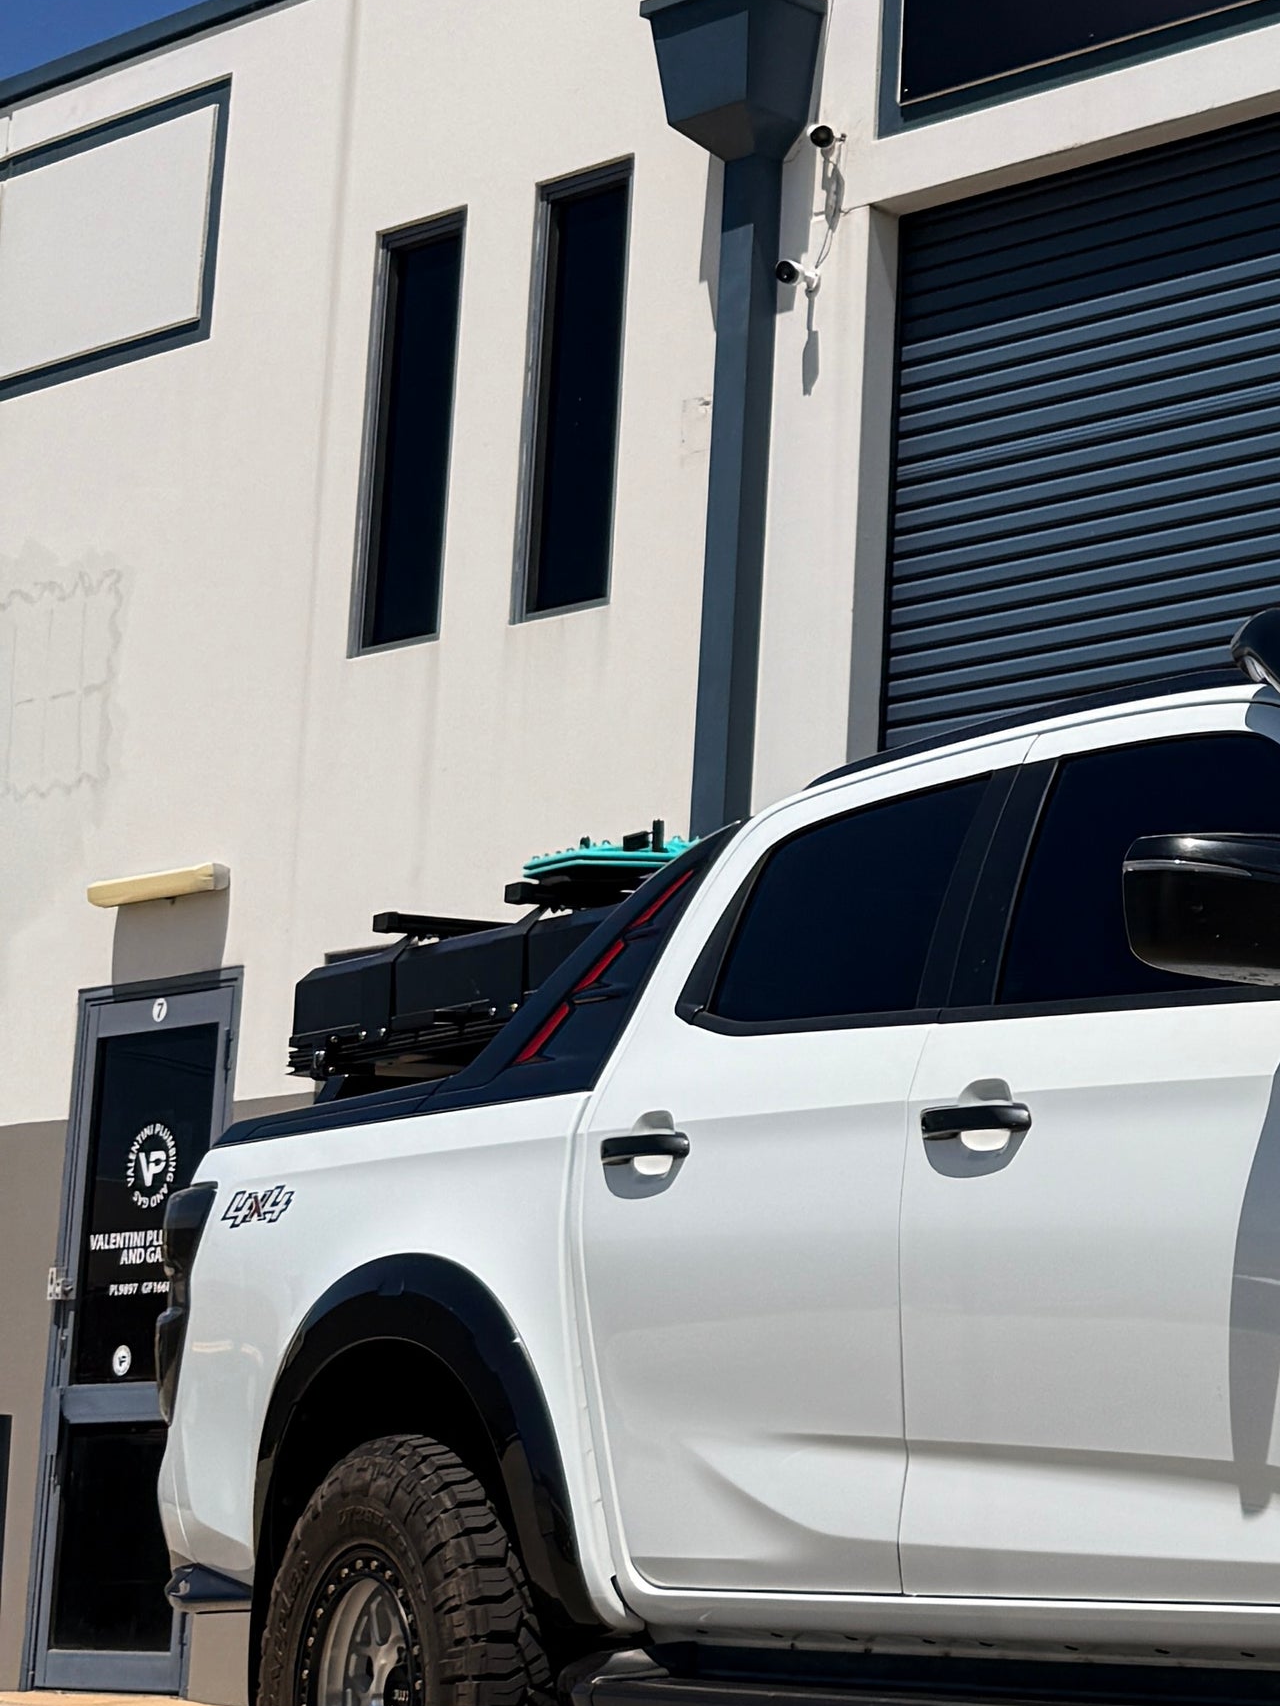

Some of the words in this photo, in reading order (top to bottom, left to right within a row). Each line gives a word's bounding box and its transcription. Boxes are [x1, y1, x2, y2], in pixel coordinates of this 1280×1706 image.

[157, 1002, 165, 1019] 7
[126, 1124, 154, 1187] VALENTINI
[154, 1123, 177, 1183] PLUMBING
[150, 1183, 168, 1207] AND
[90, 1231, 145, 1251] VALENTINI
[119, 1247, 145, 1265] AND
